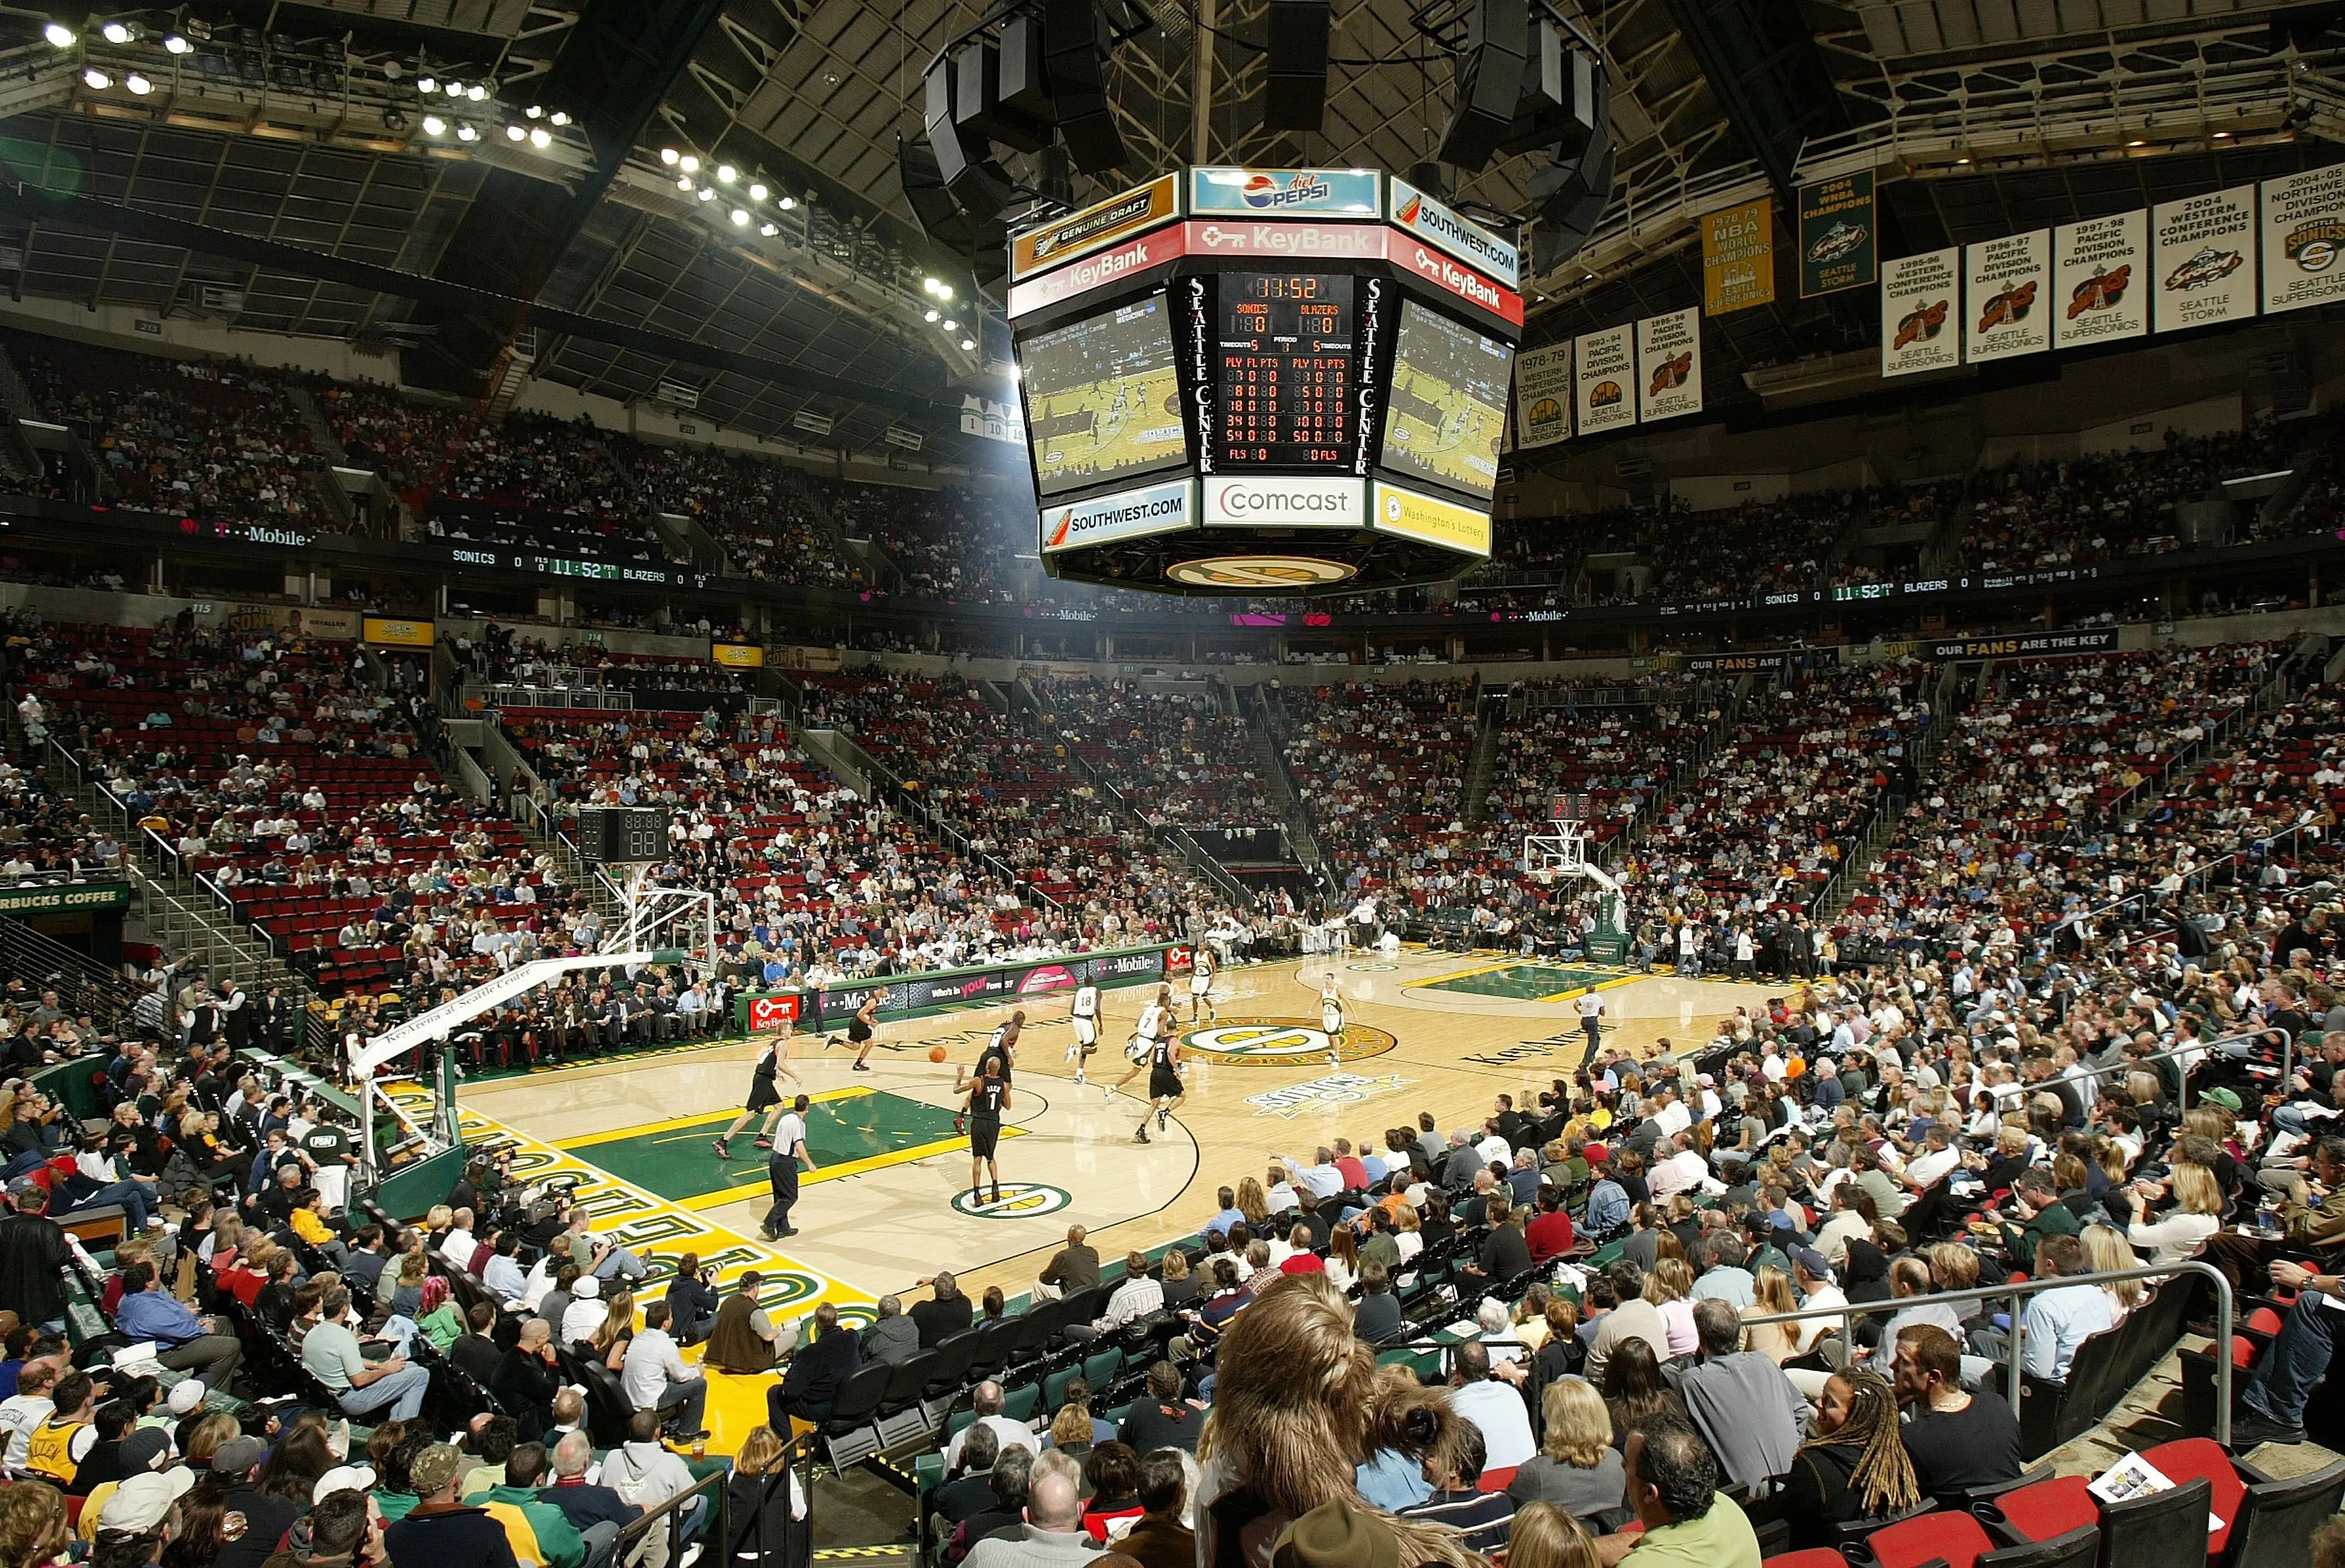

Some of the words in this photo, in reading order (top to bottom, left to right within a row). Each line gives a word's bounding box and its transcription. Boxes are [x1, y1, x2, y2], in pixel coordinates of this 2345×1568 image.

[1288, 173, 1317, 189] diet
[2289, 168, 2343, 188] 2004-05
[1273, 184, 1328, 206] PEPSI
[1822, 180, 1852, 194] 2004
[2272, 179, 2345, 203] NORTHWE
[1819, 189, 1854, 205] WNBA
[2185, 195, 2221, 211] 2004
[1803, 195, 1871, 220] CHAMPIONS
[2170, 203, 2236, 224] WESTERN
[1061, 214, 1107, 241] GENUINE
[1110, 199, 1147, 221] DRAFT
[2076, 218, 2125, 234] 1997-98
[2160, 210, 2250, 237] CONFERENCE
[1253, 225, 1369, 253] KeyBank
[1421, 206, 1514, 272] SOUTHWEST.COM
[1713, 220, 1759, 242] NBA
[2077, 228, 2121, 245] PACIFIC
[2161, 222, 2247, 247] CHAMPIONS
[1717, 234, 1757, 252] WORLD
[1985, 237, 2030, 253] 1996-97
[2074, 238, 2125, 256] DIVISION
[1705, 242, 1770, 268] CHAMPIONS
[1900, 256, 1940, 270] 1995-96
[1986, 247, 2028, 263] PACIFIC
[2063, 246, 2135, 267] CHAMPIONS
[1069, 243, 1148, 288] KeyBank
[1819, 263, 1857, 278] SEATTLE
[1896, 263, 1945, 279] WESTERN
[1984, 256, 2032, 273] DIVISION
[1821, 274, 1855, 288] STORM
[1886, 270, 1953, 290] CONFERENCE
[1975, 264, 2041, 284] CHAMPIONS
[1263, 277, 1316, 299] 11:52
[1442, 260, 1501, 310] KeyBank
[1721, 281, 1757, 296] SEATTLE
[1889, 281, 1951, 299] CHAMPIONS
[1707, 288, 1770, 309] SUPERSONICS
[2179, 294, 2230, 311] SEATTLE
[1236, 303, 1269, 314] SONICS
[1300, 305, 1339, 315] BLAZERS
[2182, 308, 2227, 323] STORM
[1255, 316, 1266, 332] 0
[1322, 317, 1333, 334] 0
[1653, 322, 1684, 335] PACIFIC
[2076, 312, 2123, 328] SEATTLE
[1190, 277, 1208, 381] SEATTLE
[1363, 278, 1380, 384] SEATTLE
[1651, 330, 1687, 345] DIVISION
[1985, 328, 2029, 343] SEATTLE
[2061, 320, 2139, 340] SUPERSONICS
[1588, 344, 1621, 358] PACIFIC
[1645, 337, 1694, 354] CHAMPIONS
[1900, 345, 1941, 360] SEATTLE
[1971, 335, 2044, 356] SUPERSONICS
[1225, 357, 1243, 367] PLY
[1247, 359, 1258, 367] FL
[1260, 359, 1278, 368] PTS
[1292, 358, 1309, 368] PLY
[1313, 359, 1325, 369] FL
[1327, 359, 1344, 369] PTS
[1519, 349, 1566, 371] 1978-79
[1587, 353, 1624, 369] DIVISION
[1888, 353, 1954, 371] SUPERSONICS
[1523, 367, 1563, 382] WESTERN
[1581, 363, 1630, 381] CHAMPIONS
[1518, 373, 1570, 393] CONFERENCE
[1521, 384, 1568, 402] CHAMPIONS
[1656, 394, 1688, 407] SEATTLE
[1591, 404, 1622, 417] SEATTLE
[1645, 400, 1699, 417] SUPERSONICS
[970, 418, 975, 429] 1
[1582, 410, 1632, 428] SUPERSONICS
[990, 423, 1001, 435] 10
[1195, 385, 1212, 473] CENTER
[1355, 388, 1374, 474] CENTER
[1531, 421, 1562, 435] SEATTLE
[1230, 449, 1247, 460] FLS
[1320, 450, 1337, 460] FLS
[1072, 498, 1183, 532] SOUTHWEST.COM
[1403, 506, 1455, 531] Washington's
[1458, 523, 1485, 540] Lottery
[453, 550, 495, 564] SONICS
[514, 557, 522, 567] 0
[553, 559, 601, 578] 11:52
[623, 568, 665, 582] BLAZERS
[677, 575, 684, 585] 0
[1764, 592, 1799, 605] SONICS
[1813, 591, 1821, 601] 0
[1836, 585, 1881, 602] 11:52
[1903, 579, 1948, 593] BLAZERS
[1960, 578, 1968, 588] 0
[192, 604, 211, 614] 115
[1936, 646, 1964, 656] OUR
[1966, 640, 2018, 656] FANS
[2020, 639, 2048, 651] ARE
[2051, 637, 2077, 649] THE
[2079, 634, 2110, 646] KEY
[1691, 660, 1713, 670] OUR
[1715, 657, 1758, 670] FANS
[1760, 657, 1782, 667] ARE
[0, 895, 60, 910] RBUCKS
[65, 891, 116, 905] COFFEE
[385, 1015, 442, 1044] KeyArena
[445, 1005, 455, 1015] at
[459, 986, 496, 1008] Seattle
[497, 968, 532, 989] Center
[1081, 997, 1091, 1007] 18
[1144, 1018, 1151, 1029] 7
[990, 1093, 997, 1110] 1
